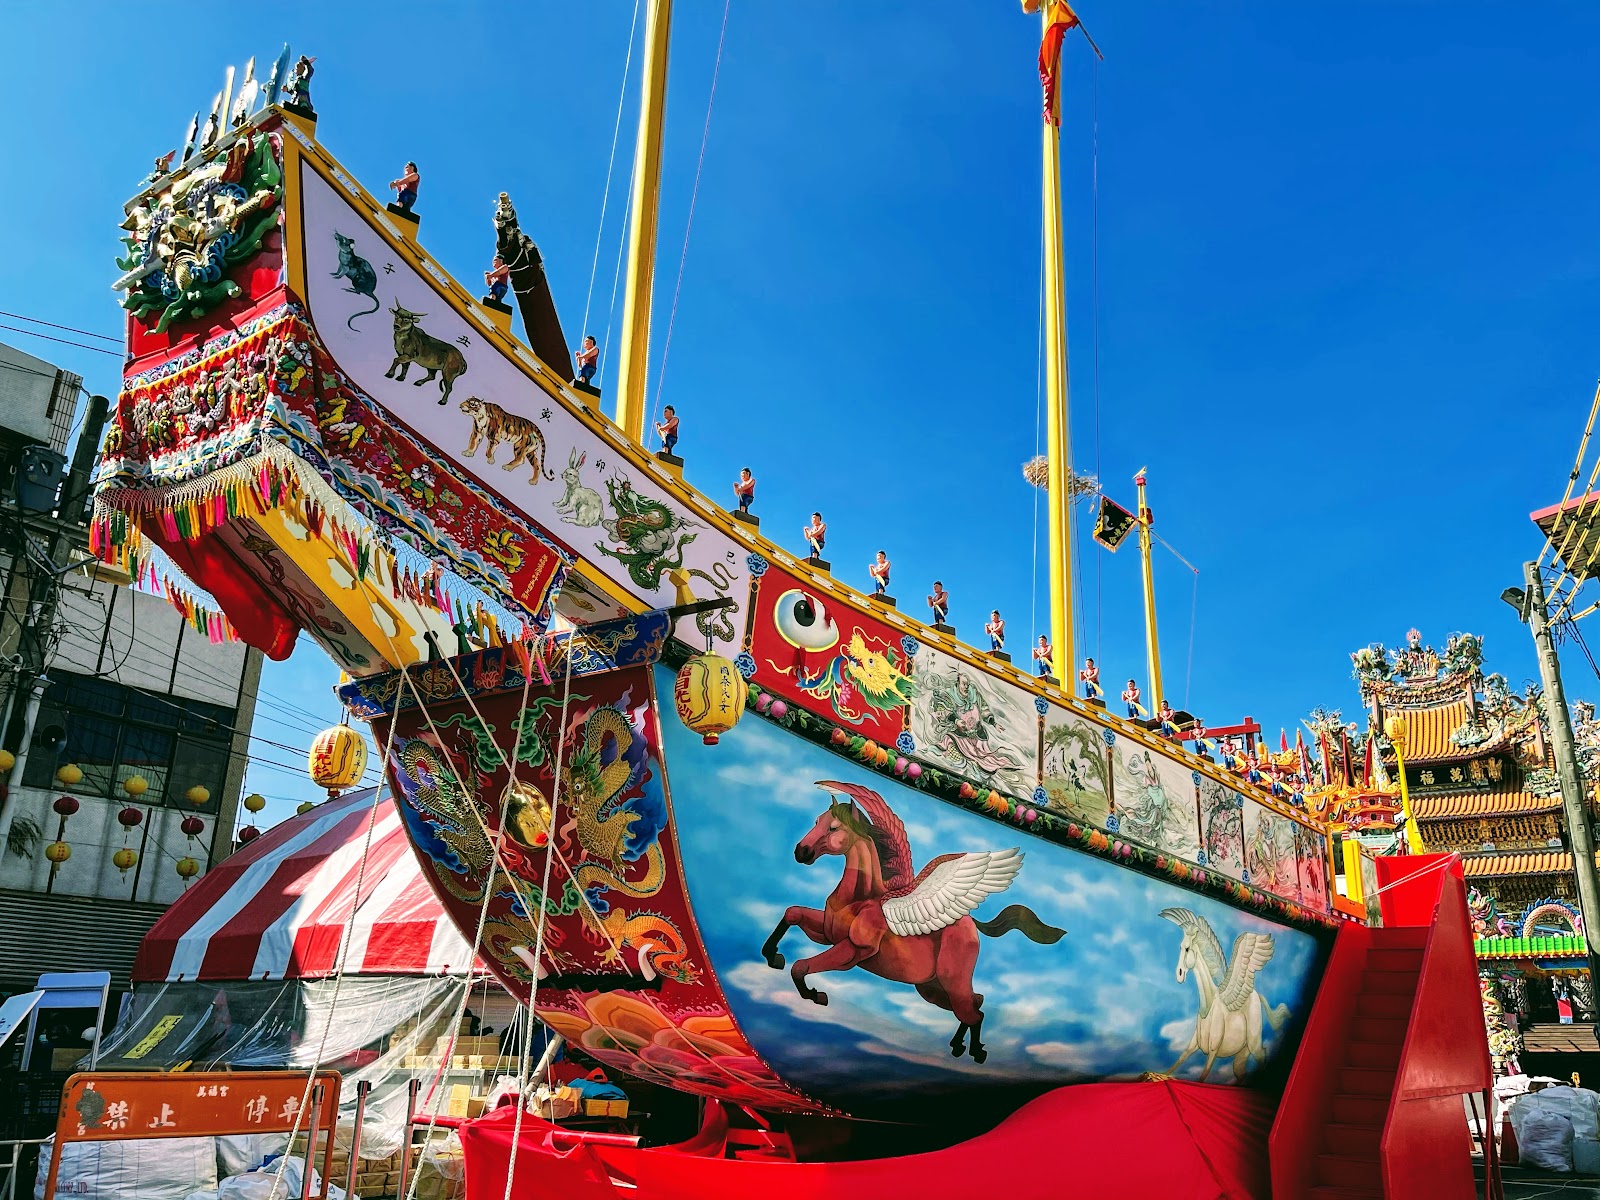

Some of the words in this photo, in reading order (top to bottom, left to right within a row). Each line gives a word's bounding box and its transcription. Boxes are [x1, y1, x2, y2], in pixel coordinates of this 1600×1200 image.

[383, 262, 396, 275] 子
[456, 335, 471, 348] 丑
[541, 408, 553, 423] 寅
[196, 1084, 230, 1098] 萬福宮
